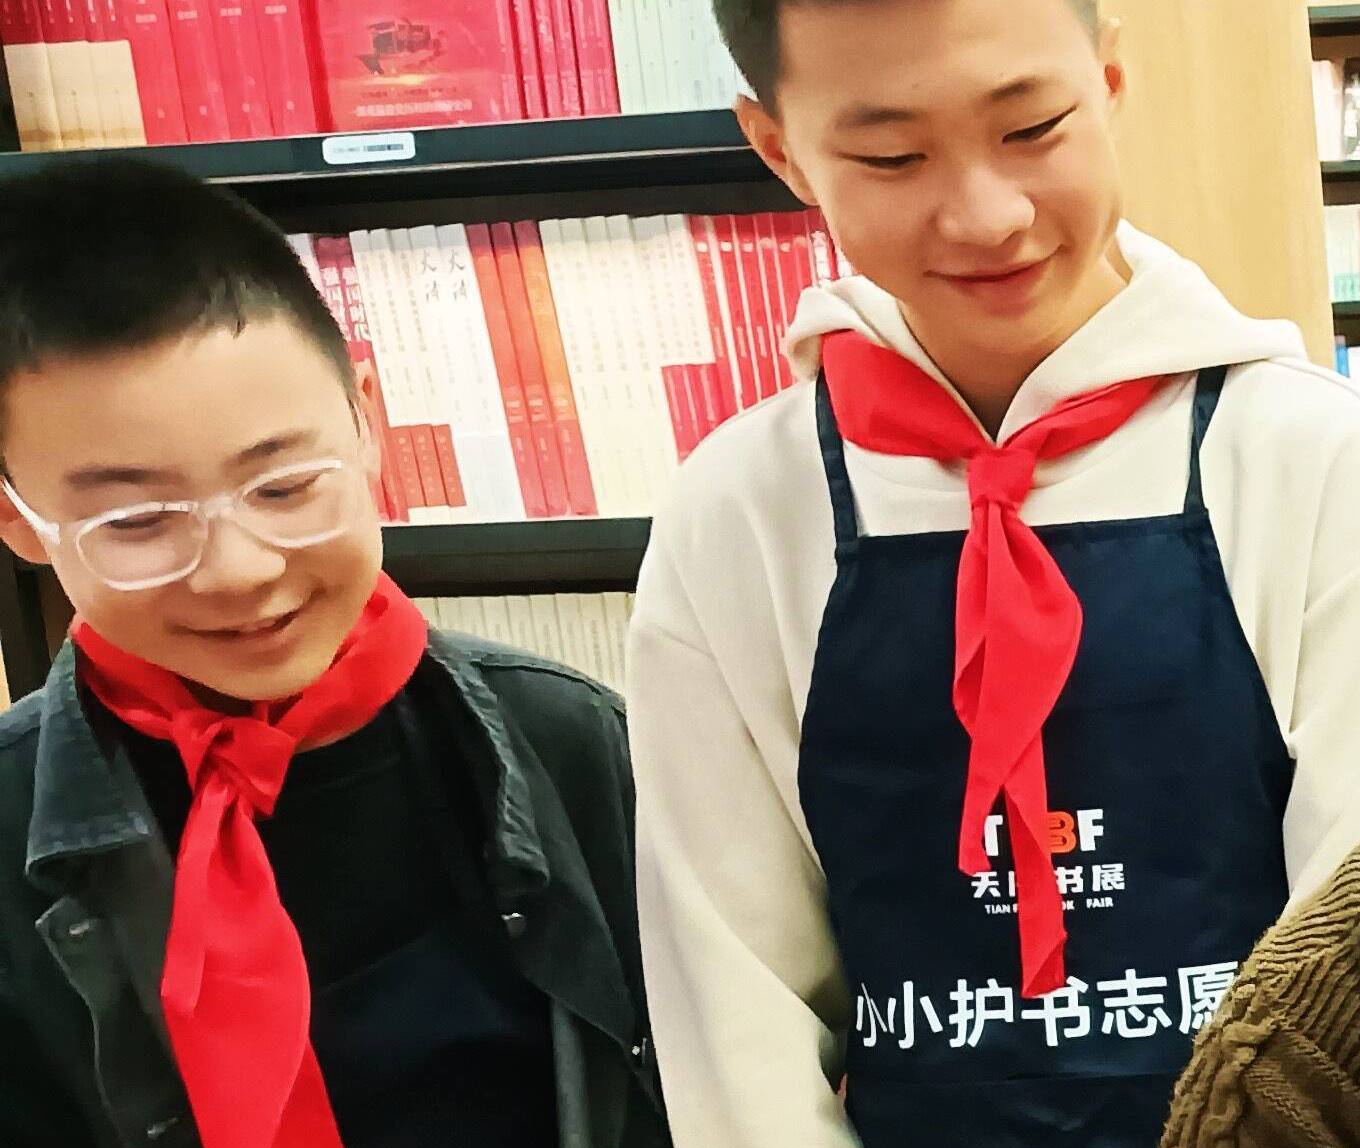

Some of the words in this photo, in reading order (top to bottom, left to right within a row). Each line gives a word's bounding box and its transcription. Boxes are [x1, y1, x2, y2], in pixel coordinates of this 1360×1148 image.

[984, 809, 1104, 857] TBF
[971, 863, 1125, 898] 天书展
[985, 903, 1010, 914] TIAN
[1086, 897, 1114, 909] FAIR
[856, 960, 1239, 1050] 小小护书志愿
